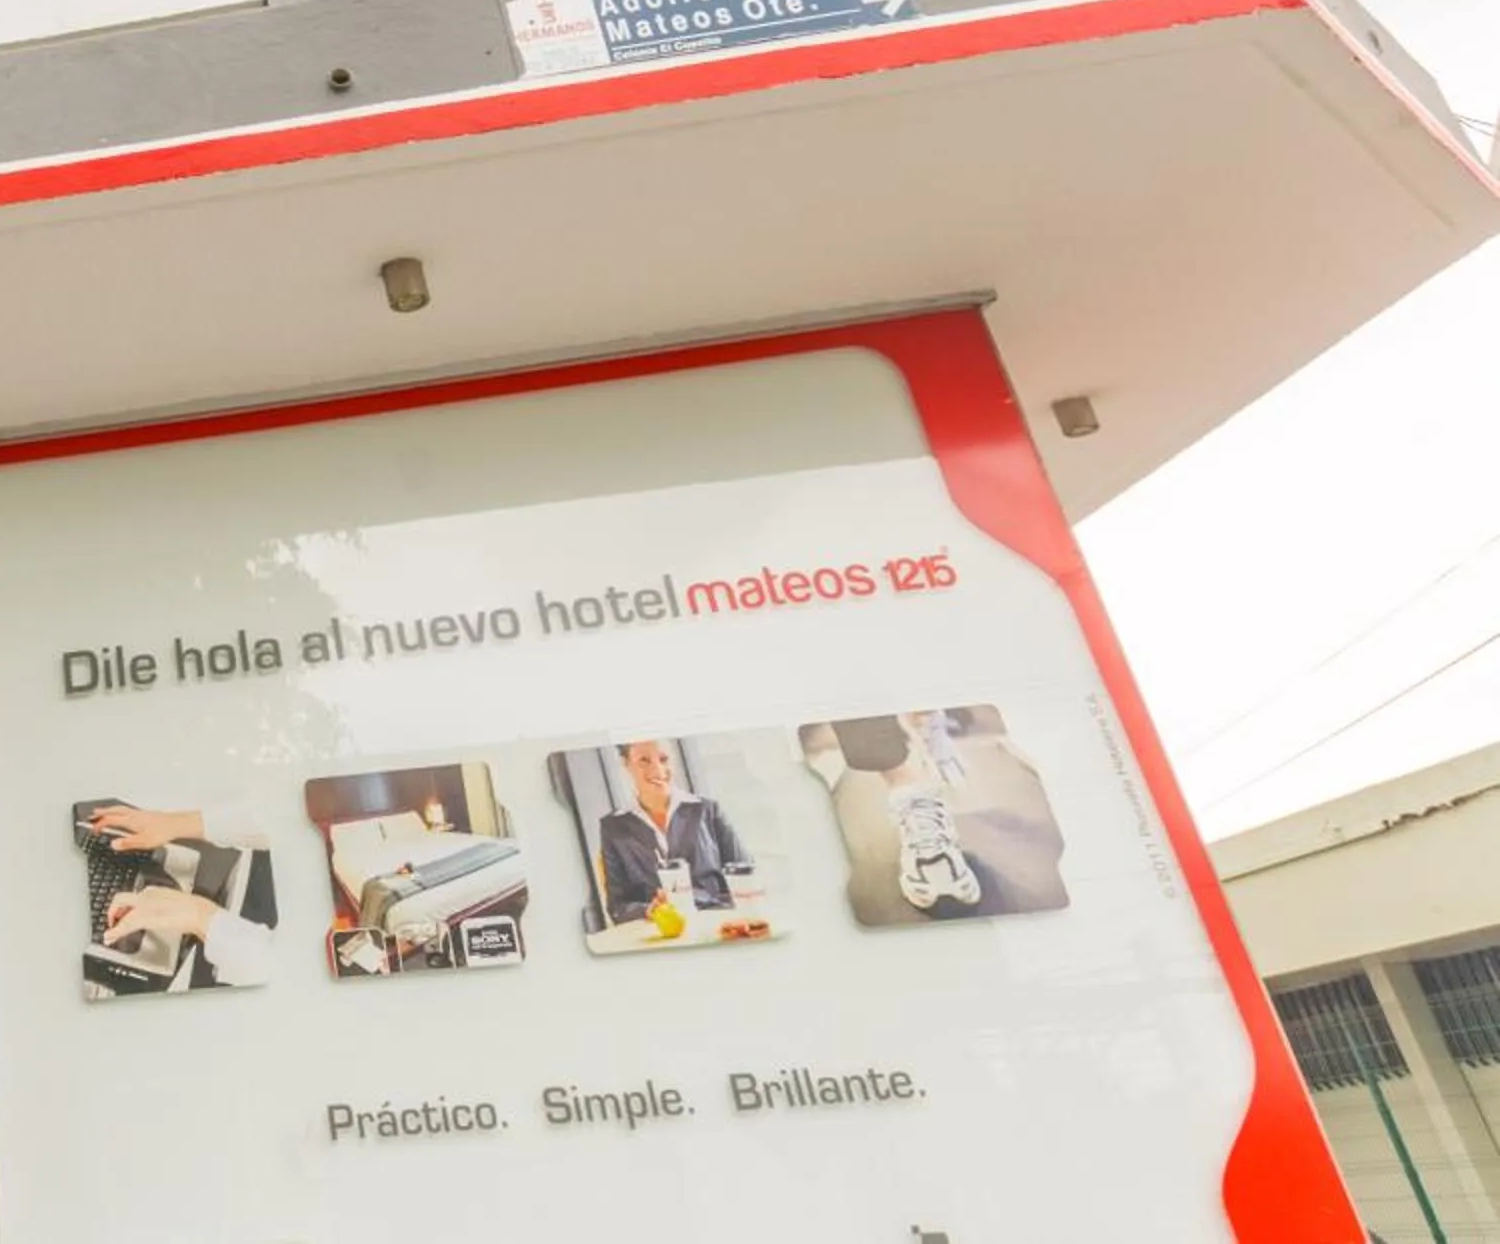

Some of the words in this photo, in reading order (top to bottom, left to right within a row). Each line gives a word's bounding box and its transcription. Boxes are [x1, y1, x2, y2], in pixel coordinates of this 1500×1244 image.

[608, 9, 732, 43] Mateos
[62, 645, 158, 697] Dile
[174, 630, 283, 680] hola
[300, 617, 345, 665] al
[361, 607, 521, 658] nuevo
[535, 574, 681, 635] hotel
[686, 563, 877, 615] mateos
[883, 555, 958, 593] 1215
[326, 1096, 509, 1141] Práctico.
[542, 1079, 696, 1129] Simple.
[728, 1066, 927, 1112] Brillante.
